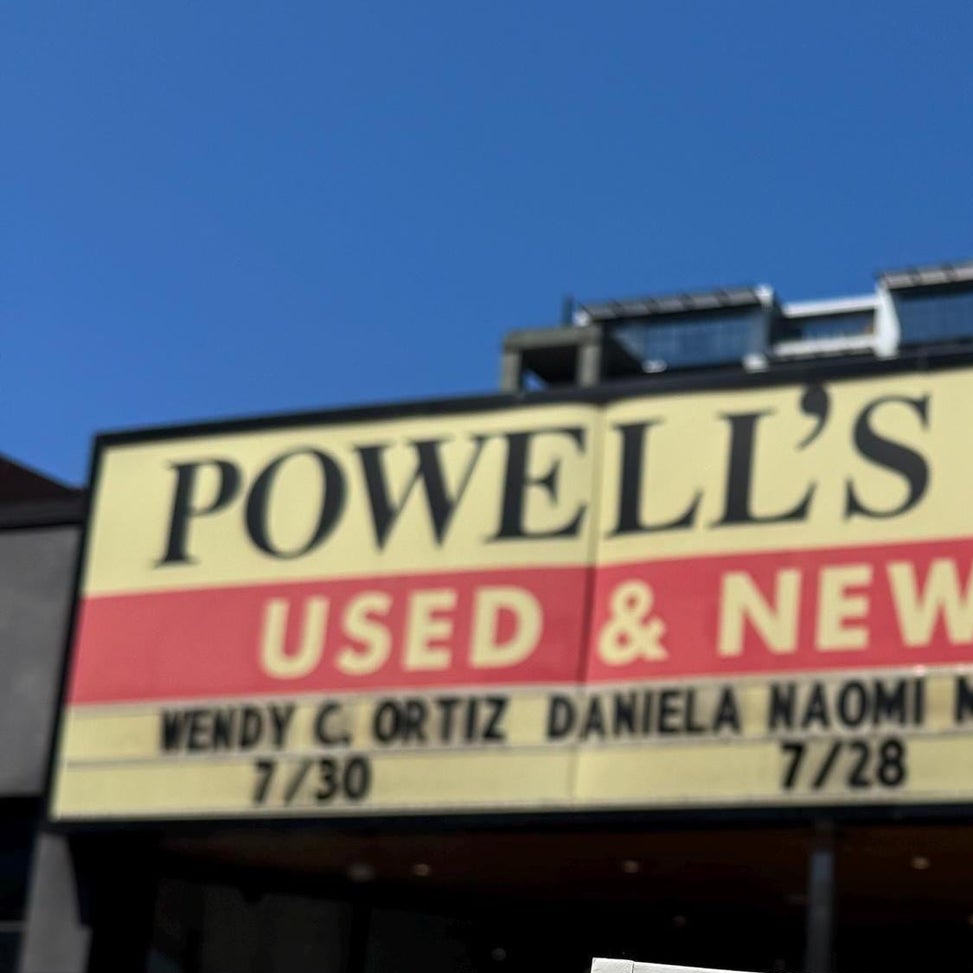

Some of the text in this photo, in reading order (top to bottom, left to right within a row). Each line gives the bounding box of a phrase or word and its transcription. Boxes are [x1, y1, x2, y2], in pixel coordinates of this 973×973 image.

[153, 384, 931, 568] POWELL'S
[259, 586, 543, 679] USED
[597, 580, 669, 666] &
[160, 698, 509, 753] WENDY C. ORTIZ
[545, 686, 740, 740] DANIELA
[767, 678, 923, 731] NAOMI
[252, 758, 371, 806] 7/30
[780, 738, 908, 791] 7/28
